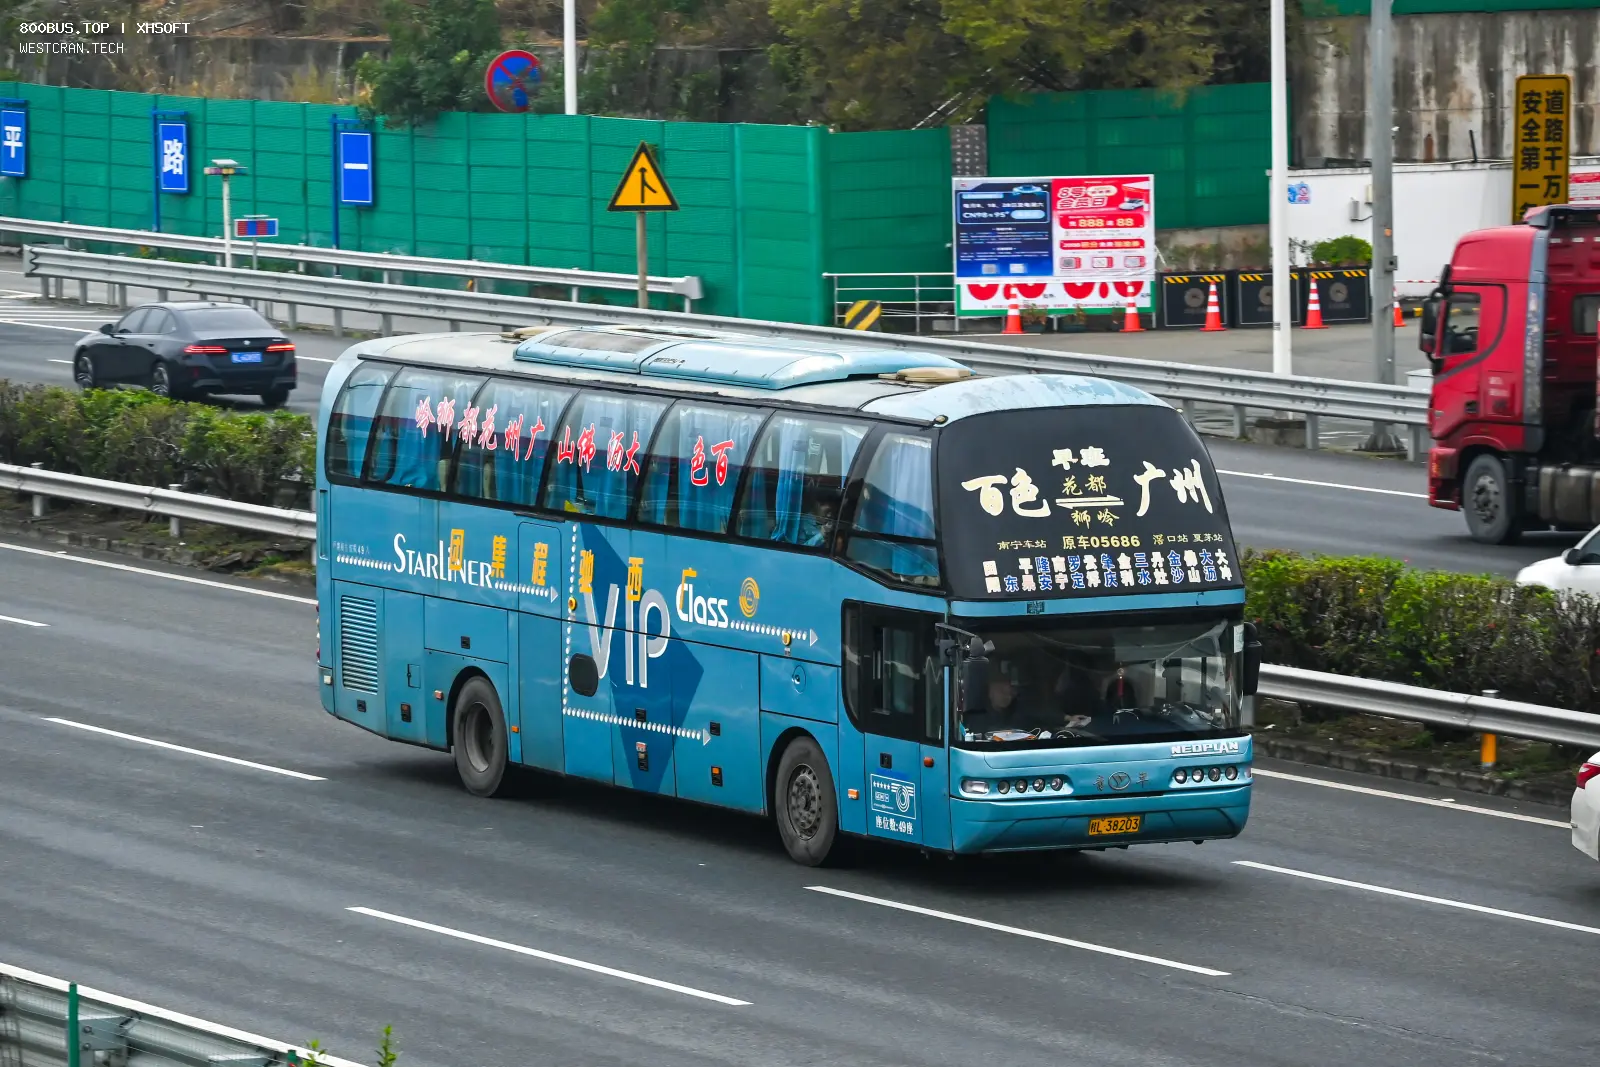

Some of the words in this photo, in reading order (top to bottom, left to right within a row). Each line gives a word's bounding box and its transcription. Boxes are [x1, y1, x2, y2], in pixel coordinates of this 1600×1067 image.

[3, 126, 23, 159] 平
[162, 138, 185, 175] 路
[1543, 90, 1564, 204] 道路千万
[691, 436, 734, 486] 百色
[961, 467, 1052, 517] 百色
[1133, 459, 1213, 517] 广州
[1062, 474, 1107, 496] 花都
[1071, 508, 1120, 529] 狮岭
[1062, 535, 1141, 550] 原车05686
[1035, 556, 1053, 590] 隆安
[1067, 554, 1085, 589] 罗定
[1134, 552, 1152, 585] 三水
[1167, 549, 1185, 583] 金沙
[1199, 548, 1218, 582] 大沥
[675, 582, 729, 629] Class
[1171, 741, 1239, 754] NEOPLAN
